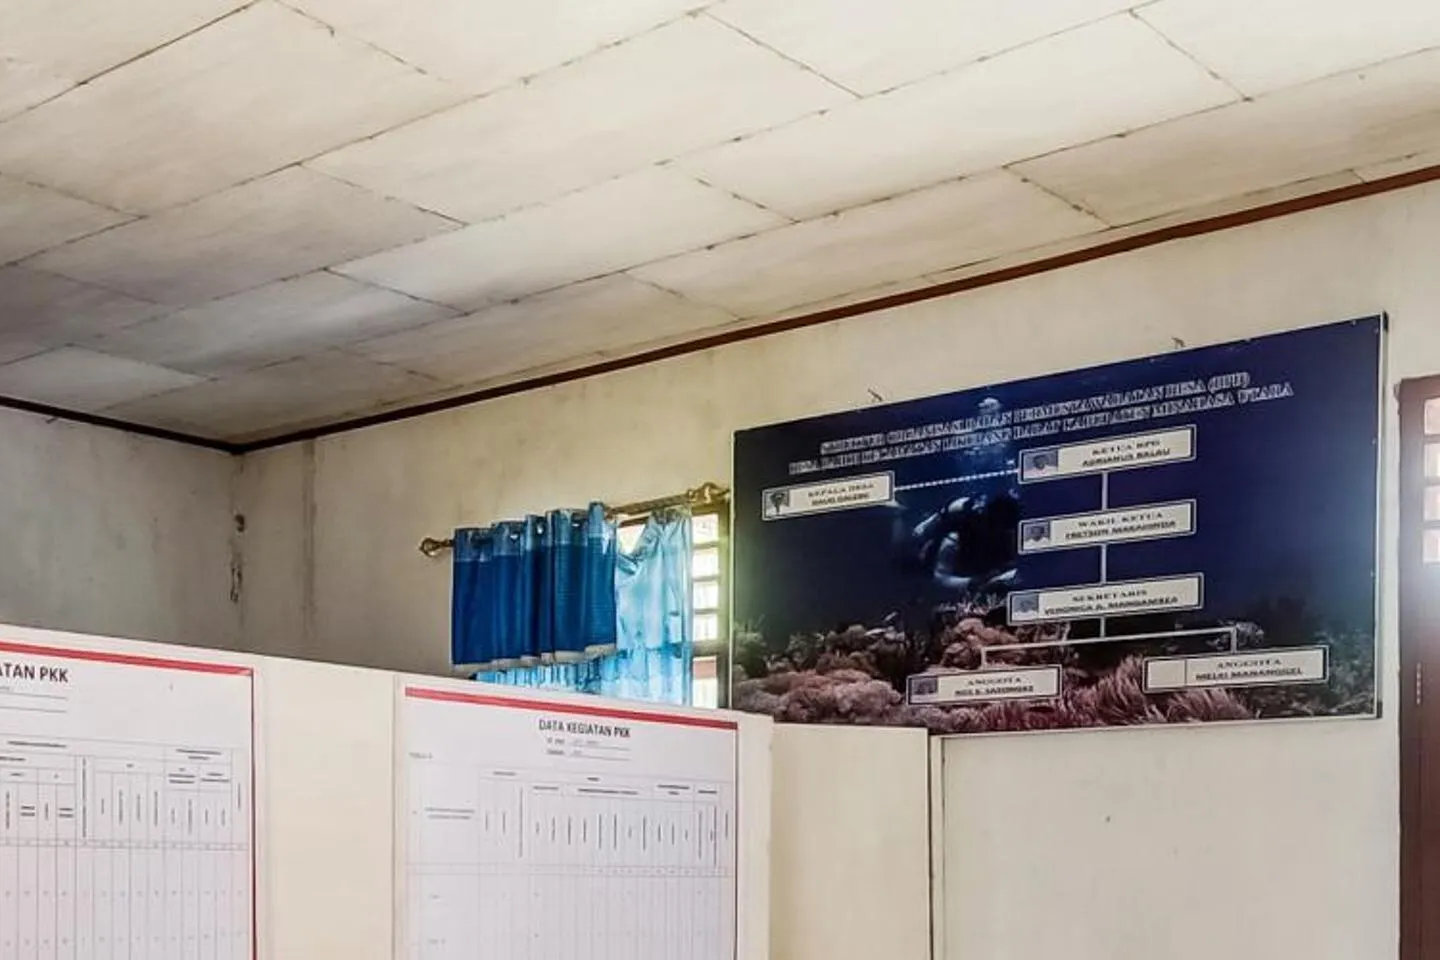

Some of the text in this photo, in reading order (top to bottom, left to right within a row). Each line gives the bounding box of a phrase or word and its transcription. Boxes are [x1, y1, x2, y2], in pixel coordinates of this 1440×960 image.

[39, 666, 69, 683] PKK
[539, 719, 630, 738] DATA KEGIATAN PKK
